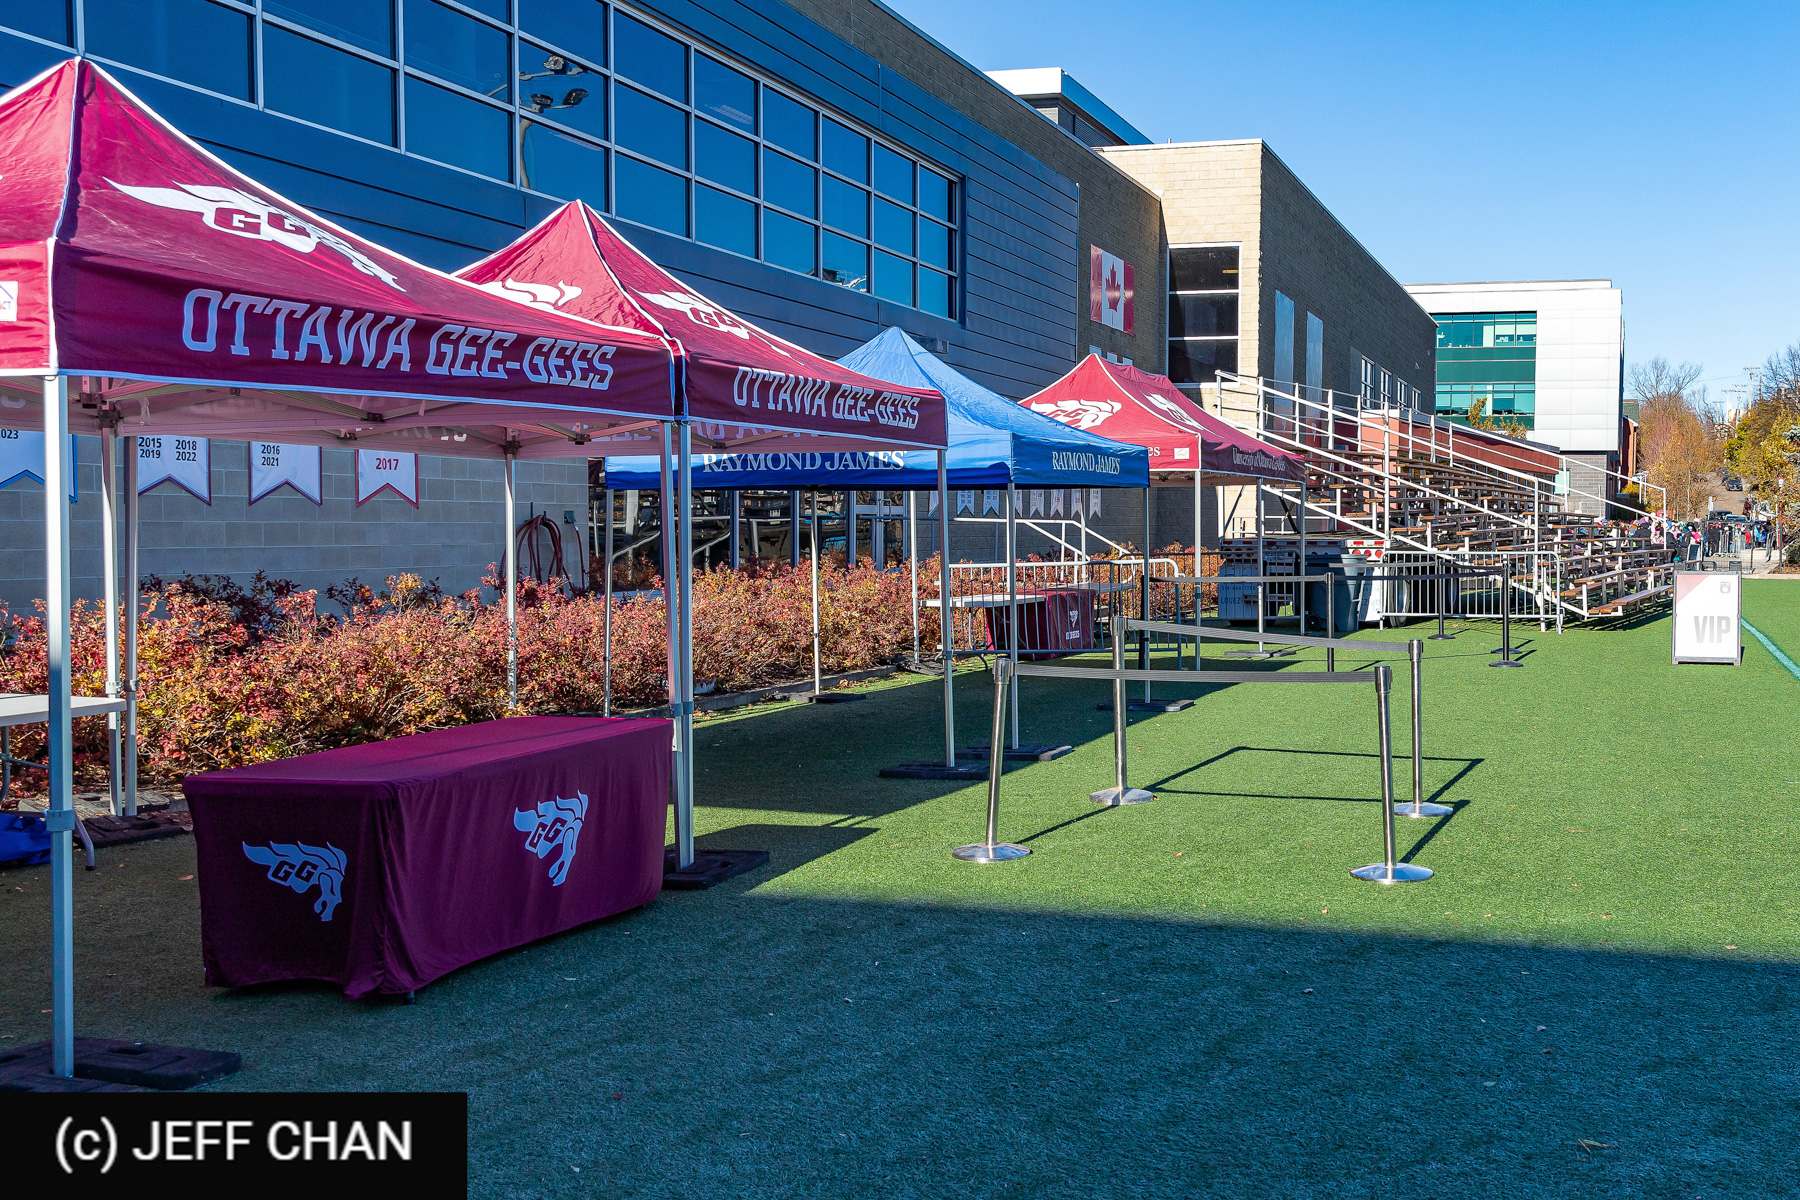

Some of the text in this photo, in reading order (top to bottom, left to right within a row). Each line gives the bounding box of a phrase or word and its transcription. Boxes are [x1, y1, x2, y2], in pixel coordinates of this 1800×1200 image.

[183, 288, 616, 391] OTTAWA GEE-GEES
[733, 366, 920, 429] OTTAWA GEE-GEES
[0, 429, 19, 440] 023
[138, 437, 197, 451] 2015 2018
[261, 444, 280, 455] 2016
[139, 449, 197, 462] 2019 2022
[261, 456, 279, 467] 2021
[702, 450, 905, 473] RAYMOND JAMES
[375, 457, 399, 470] 2017
[1052, 451, 1120, 475] RAYMOND JAMES
[1693, 615, 1731, 644] VIP
